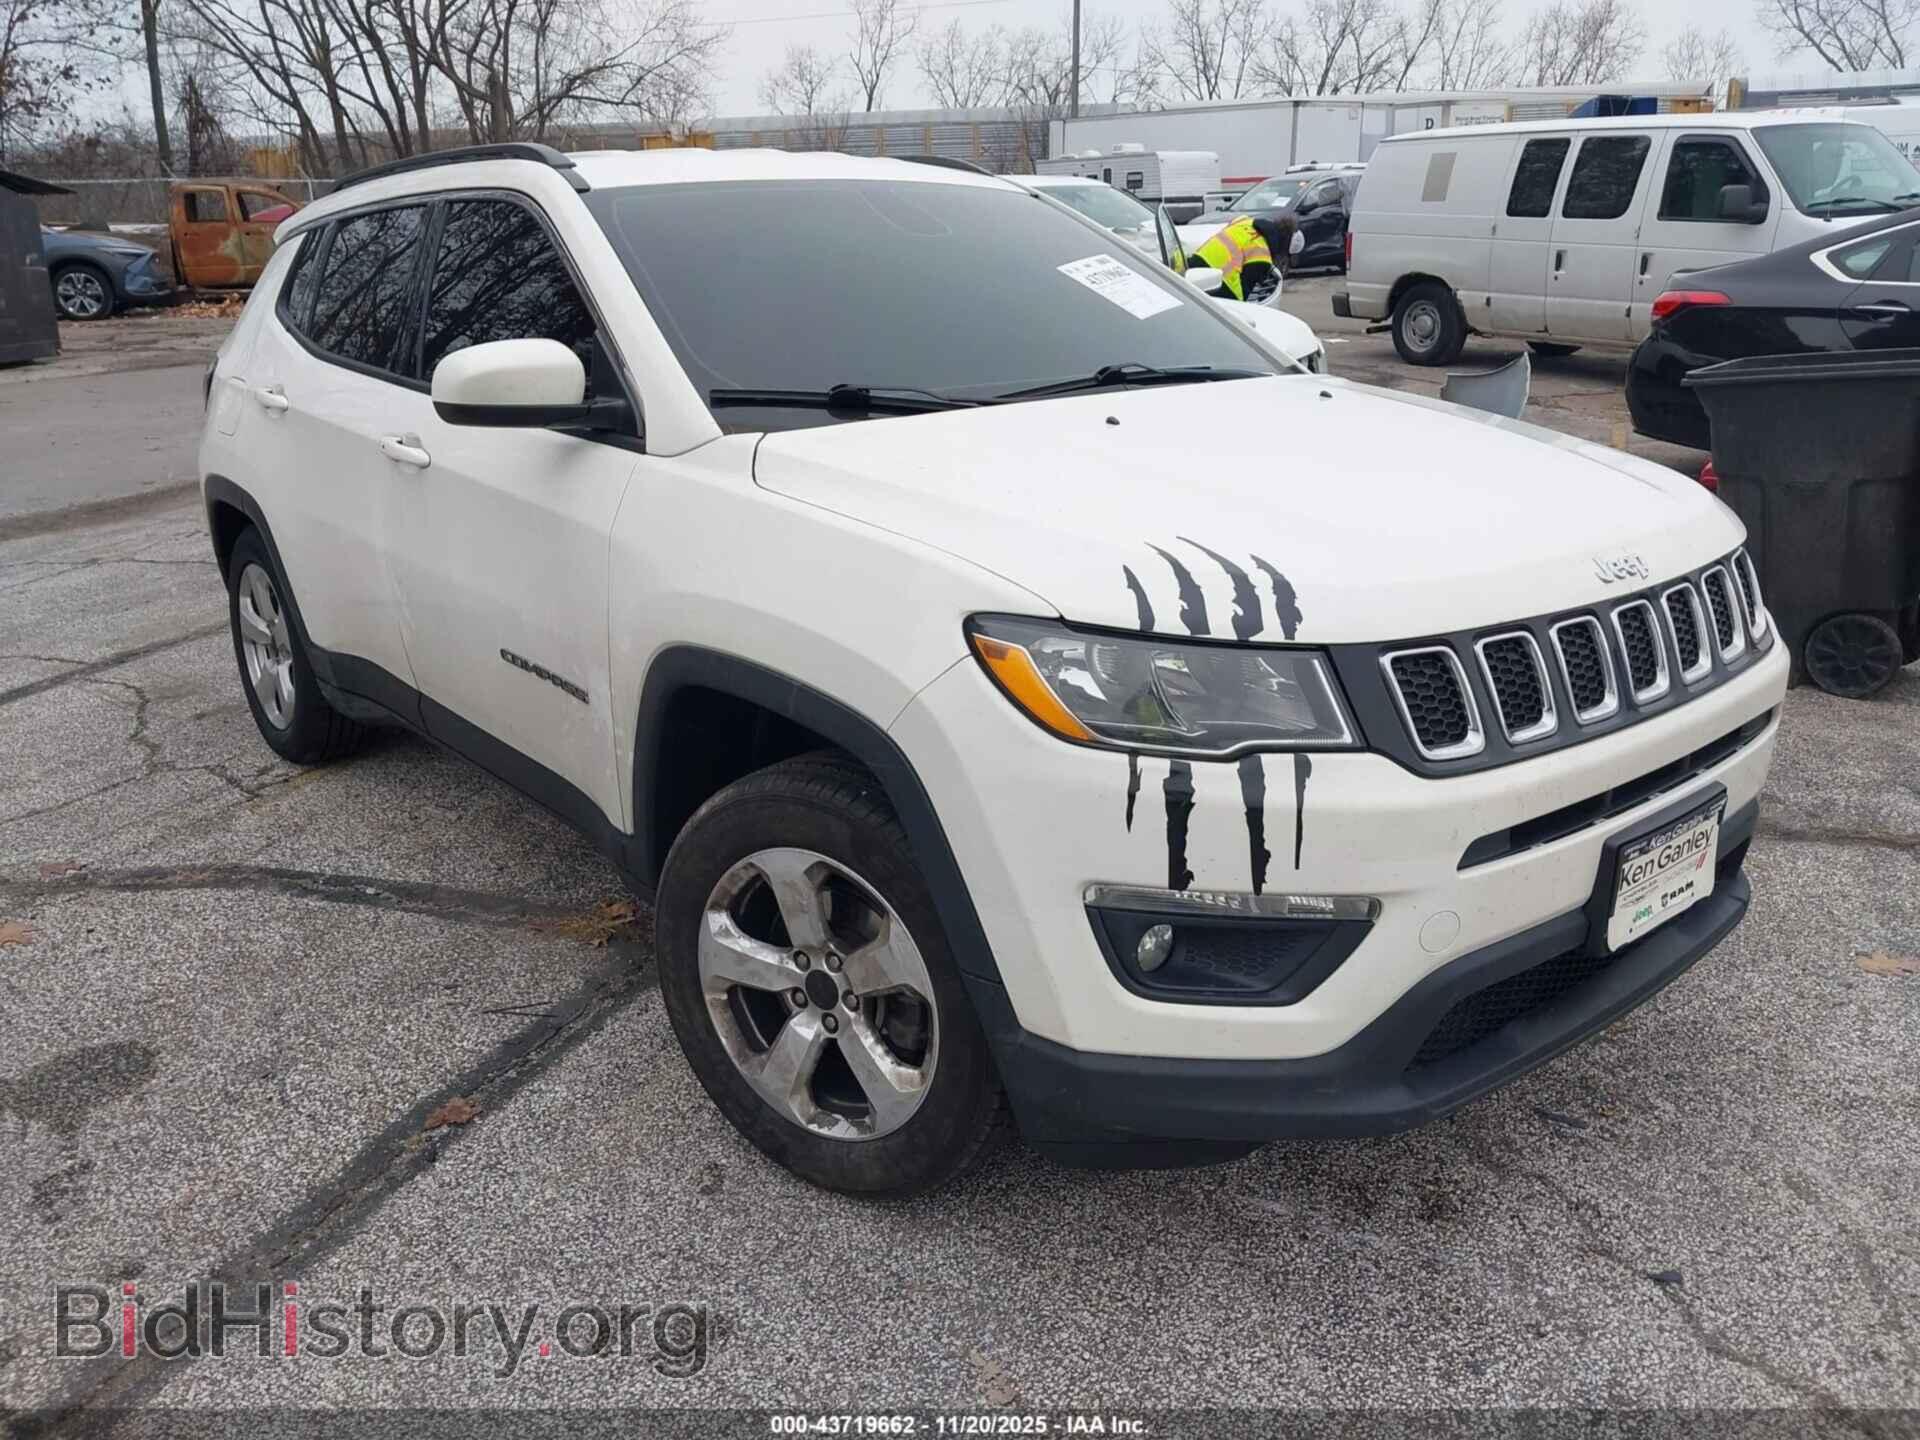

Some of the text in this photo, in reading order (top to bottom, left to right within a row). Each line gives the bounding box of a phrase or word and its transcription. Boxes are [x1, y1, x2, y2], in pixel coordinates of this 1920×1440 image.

[1592, 554, 1649, 584] Jeep
[1648, 833, 1672, 849] Ken
[1619, 858, 1655, 892] Ken
[1657, 824, 1714, 870] Ganley
[1669, 880, 1694, 900] RAM
